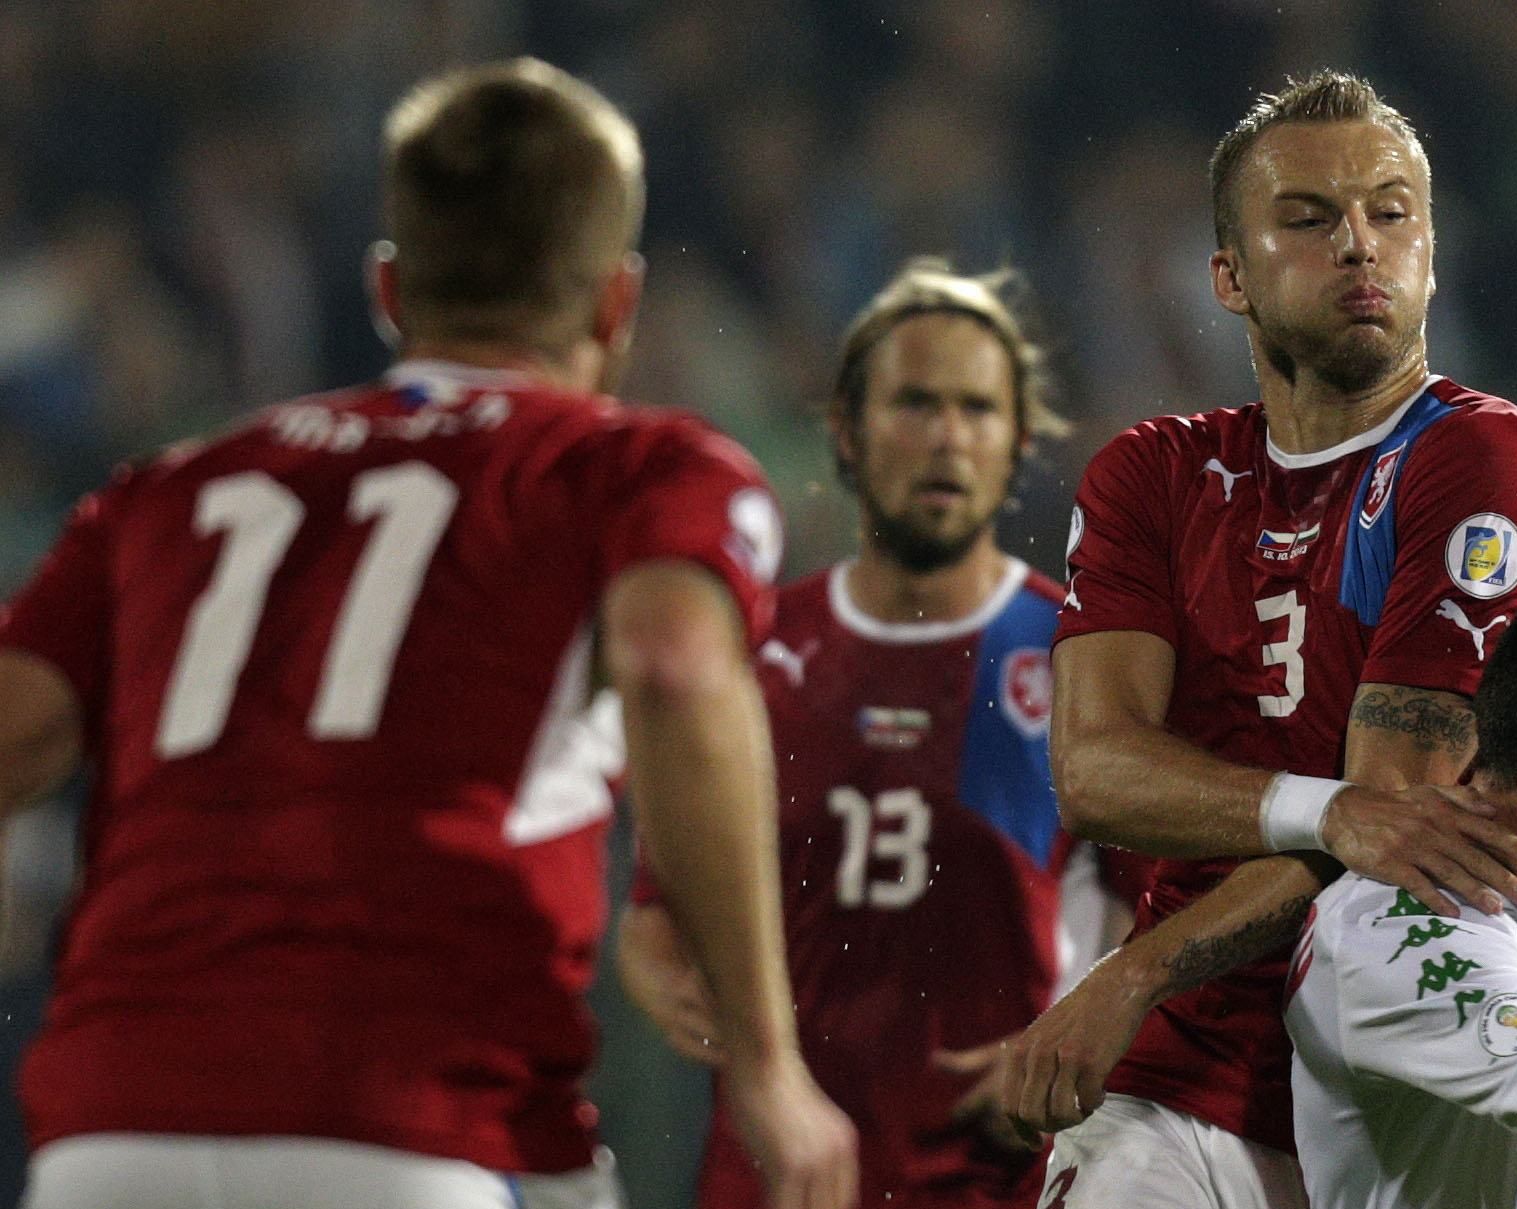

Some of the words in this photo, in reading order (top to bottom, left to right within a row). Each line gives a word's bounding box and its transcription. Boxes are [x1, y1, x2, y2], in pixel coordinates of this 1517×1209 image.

[156, 458, 458, 760] 11
[1254, 589, 1307, 718] 3
[826, 786, 933, 907] 13
